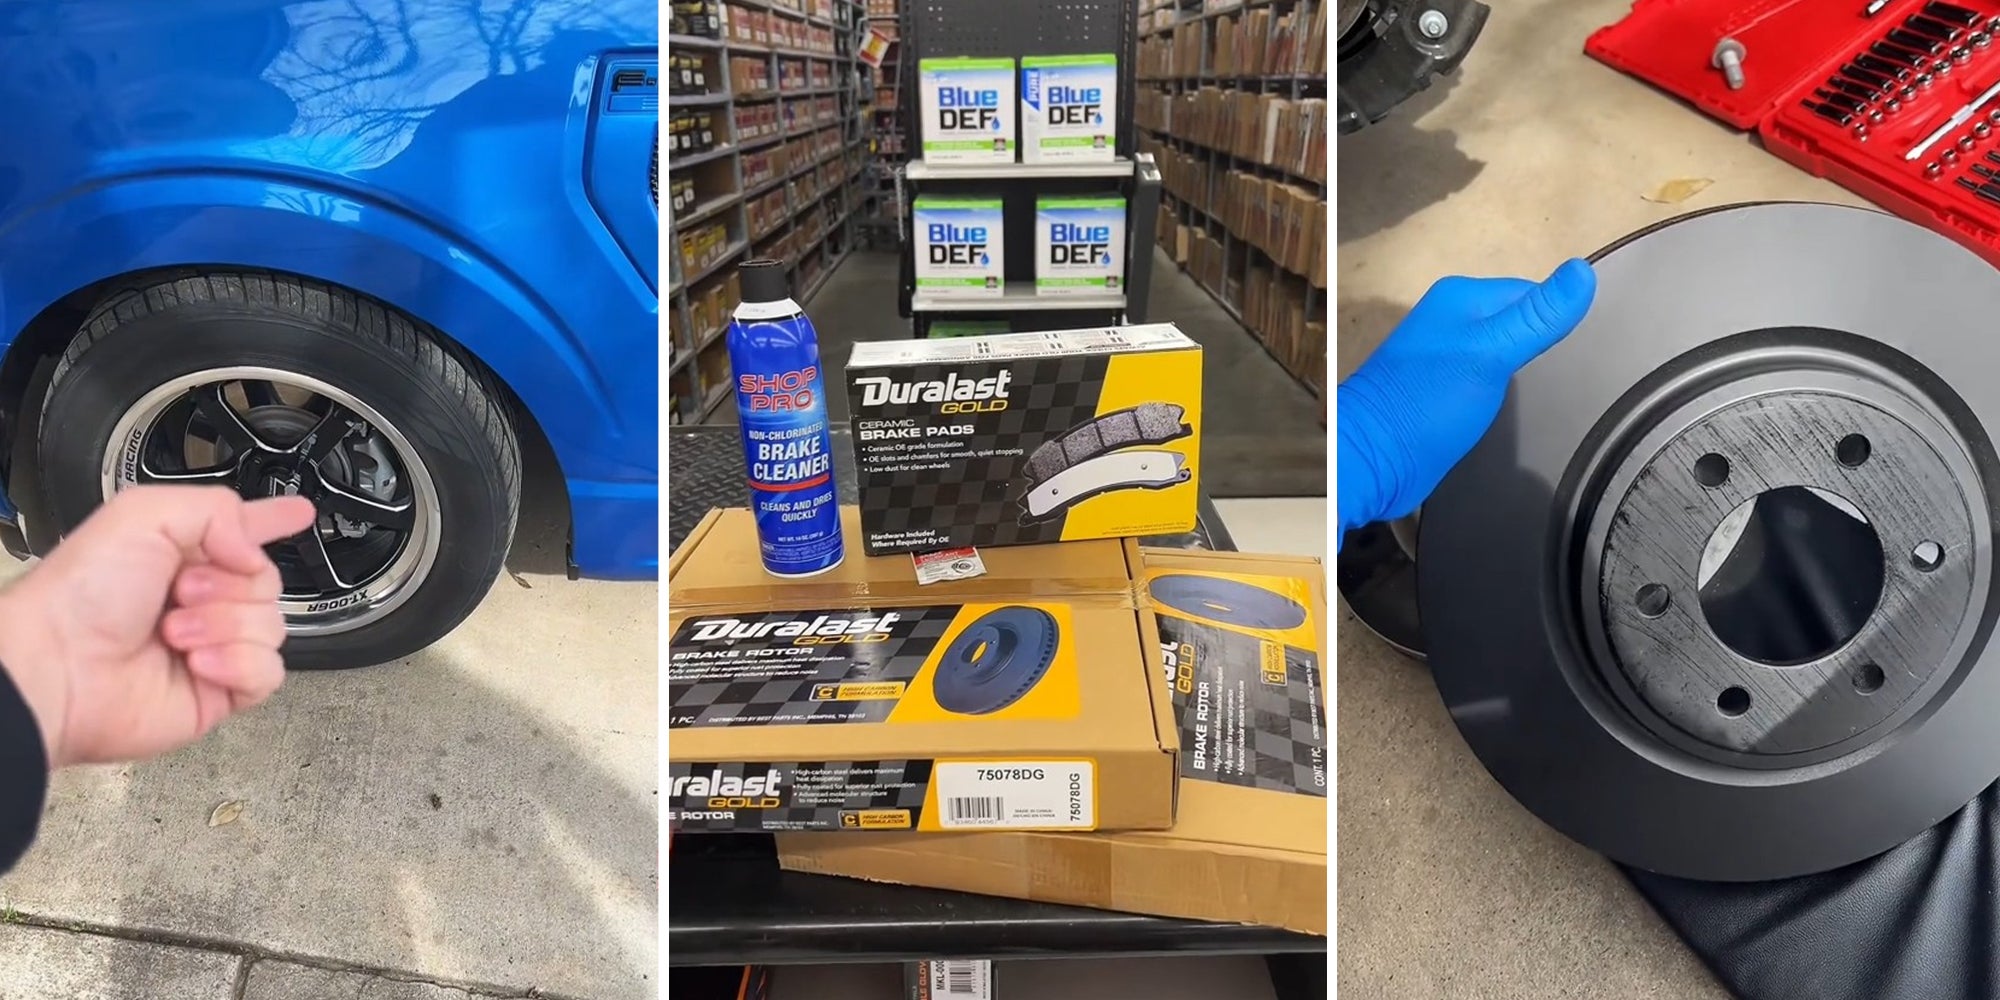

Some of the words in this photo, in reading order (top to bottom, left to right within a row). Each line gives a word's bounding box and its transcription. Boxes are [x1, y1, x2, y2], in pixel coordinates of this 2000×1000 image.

[938, 87, 998, 107] Blue
[1048, 86, 1101, 104] Blue
[939, 108, 997, 130] DEF
[1048, 104, 1101, 125] DEF
[928, 223, 987, 242] Blue
[1051, 223, 1109, 242] Blue
[929, 244, 987, 264] DEF
[1051, 244, 1109, 264] DEF
[740, 366, 817, 393] SHOP
[855, 369, 1010, 406] Duralast
[751, 388, 813, 413] PRO
[940, 399, 1008, 414] GOLD
[859, 419, 915, 430] CERAMIC
[860, 427, 921, 440] BRAKE
[926, 425, 974, 437] PADS
[125, 428, 142, 482] RACING
[758, 436, 821, 461] BRAKE
[867, 444, 895, 452] Ceramic
[895, 443, 906, 451] OE
[907, 442, 927, 452] grade
[927, 440, 964, 449] formulation
[868, 455, 880, 463] OE
[880, 454, 896, 462] slots
[897, 453, 910, 461] and
[910, 452, 939, 460] chamfers
[951, 449, 976, 457] smooth,
[977, 448, 994, 457] quiet
[995, 447, 1024, 456] stopping
[753, 453, 829, 481] CLEANER
[869, 465, 883, 473] Low
[884, 464, 899, 472] dust
[899, 463, 909, 471] for
[910, 463, 928, 471] clean
[928, 461, 951, 469] wheels
[760, 501, 791, 512] CLEANS
[792, 500, 812, 511] AND
[813, 491, 833, 507] DRIES
[781, 508, 818, 523] QUICKLY
[871, 532, 905, 540] Hardware
[906, 530, 935, 538] Included
[871, 540, 895, 548] Where
[896, 538, 927, 547] Required
[928, 537, 937, 545] By
[690, 611, 898, 642] Duralast
[793, 632, 891, 646] GOLD
[672, 650, 741, 660] BRAKE
[745, 647, 814, 657] ROTOR
[1177, 643, 1194, 694] GOLD
[1197, 681, 1209, 721] ROTOR
[670, 716, 676, 724] 1
[678, 716, 697, 724] PC.
[1193, 724, 1207, 770] BRAKE
[1311, 747, 1321, 758] PC.
[977, 769, 1045, 781] 75078DG
[1312, 764, 1325, 787] CONT.
[708, 797, 781, 808] GOLD
[1069, 773, 1081, 821] 75078DG
[681, 811, 735, 820] ROTOR
